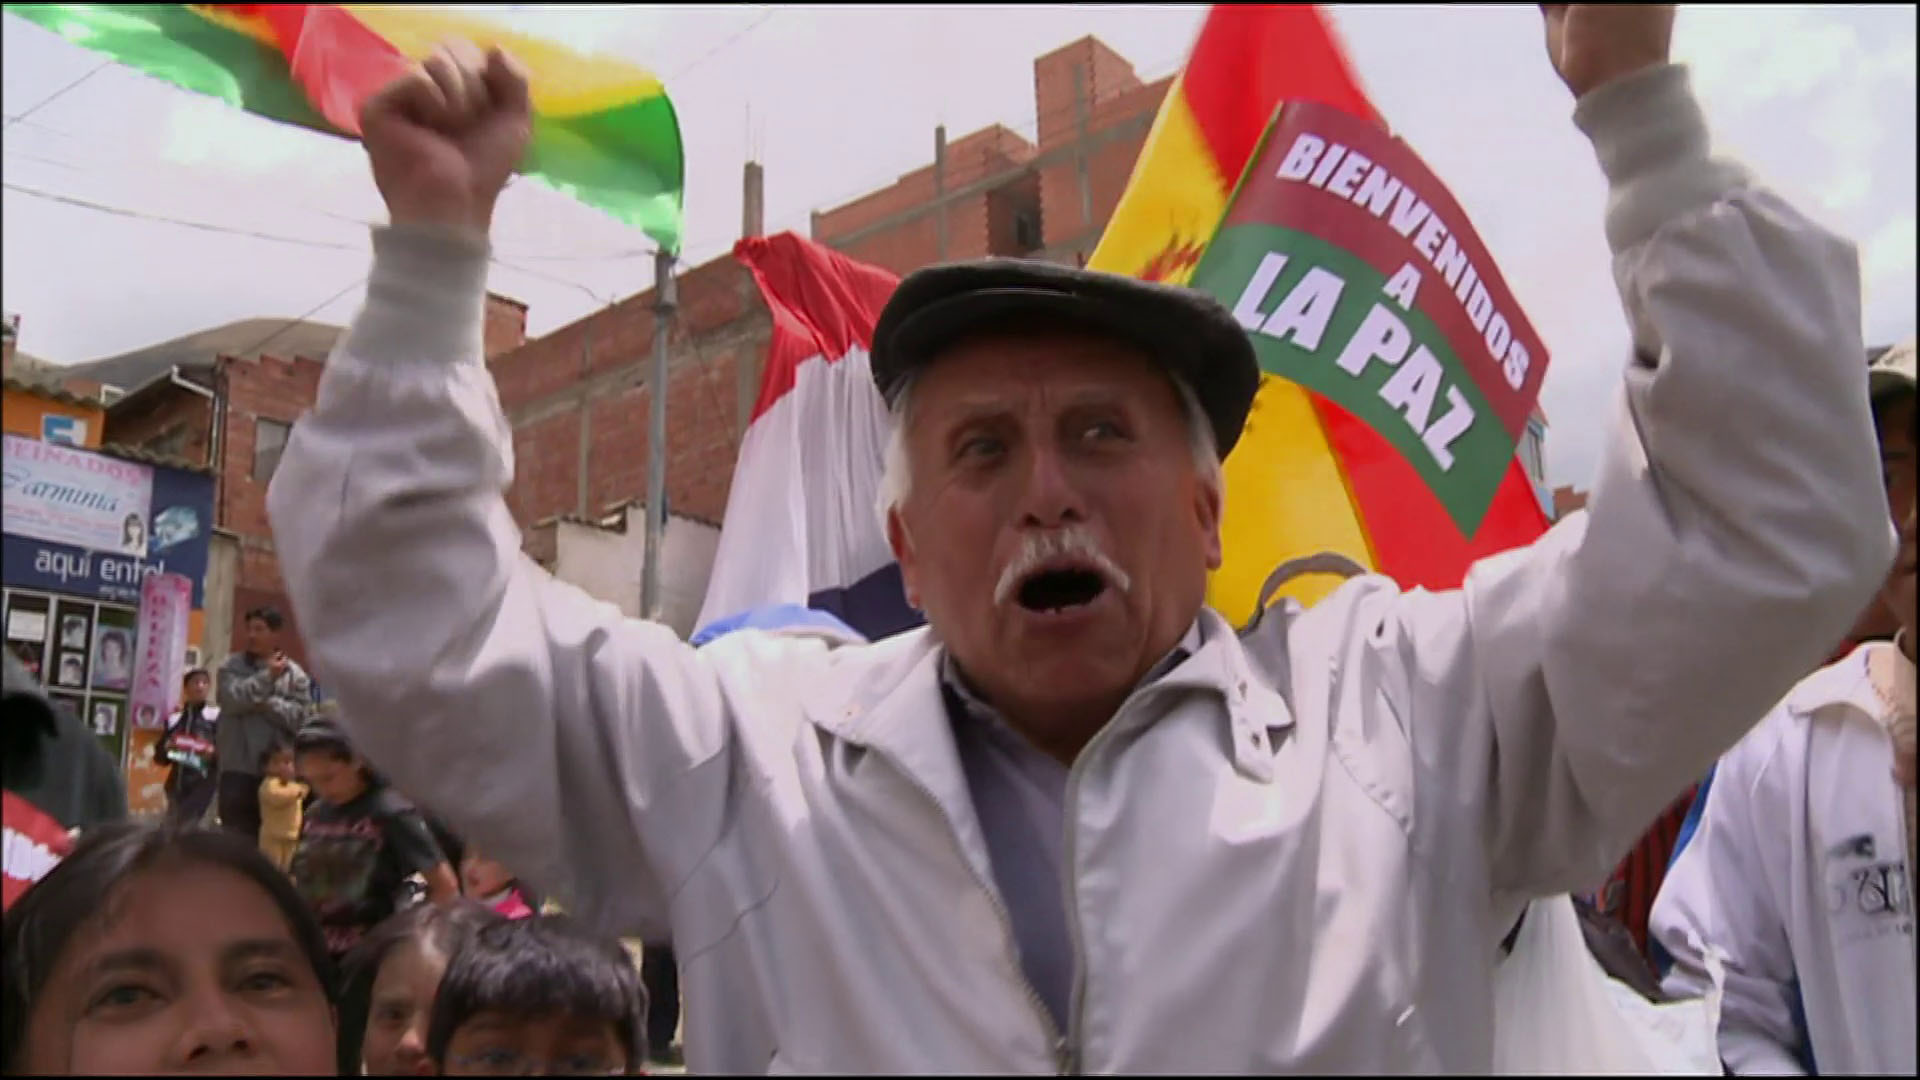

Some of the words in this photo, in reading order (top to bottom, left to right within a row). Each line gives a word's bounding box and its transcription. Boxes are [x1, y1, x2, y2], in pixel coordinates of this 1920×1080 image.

[1232, 251, 1345, 352] LA
[1336, 303, 1476, 472] PAZ
[1276, 132, 1530, 391] BIENVENIDOS
[1382, 262, 1421, 311] A
